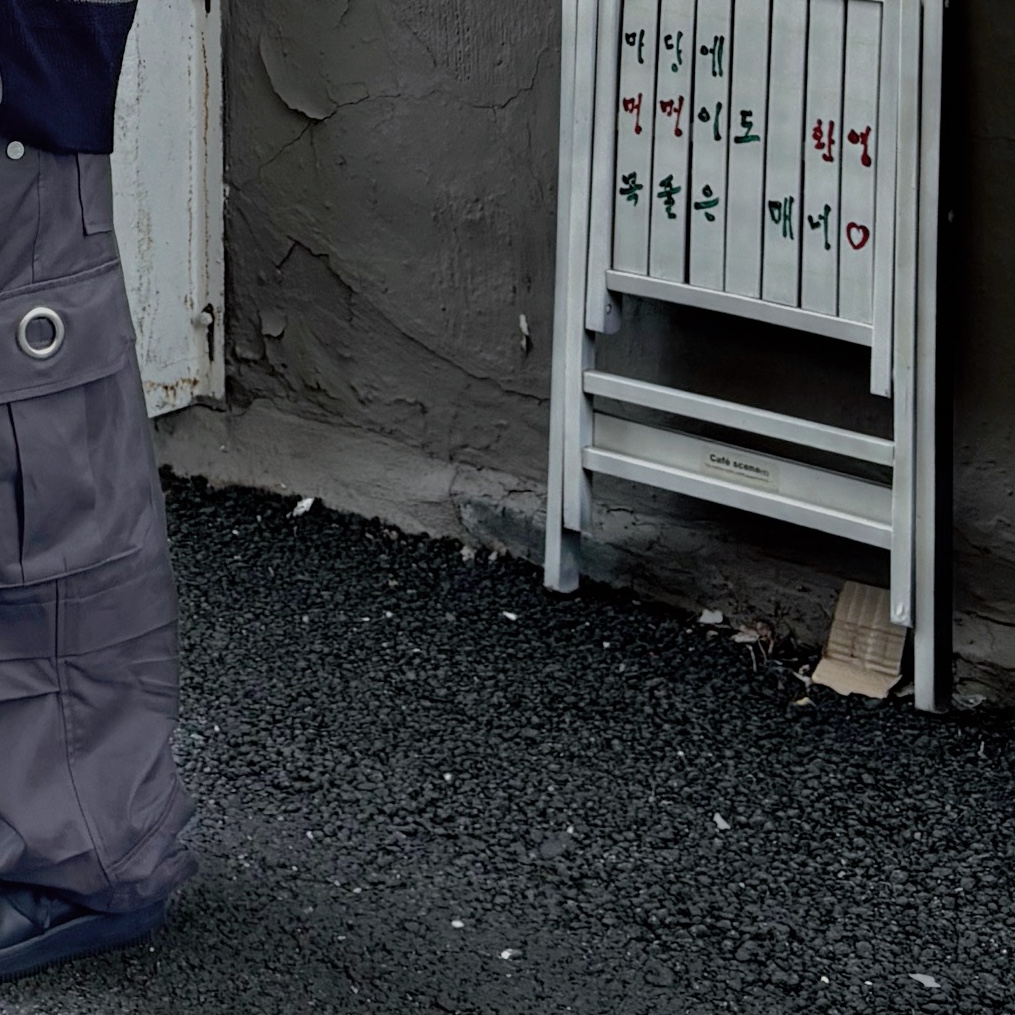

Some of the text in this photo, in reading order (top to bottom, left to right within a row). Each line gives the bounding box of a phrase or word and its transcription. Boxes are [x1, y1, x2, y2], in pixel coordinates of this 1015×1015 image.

[625, 29, 724, 77] 마당에
[622, 92, 872, 167] 멍멍이도 환영
[619, 171, 720, 222] 목줄은
